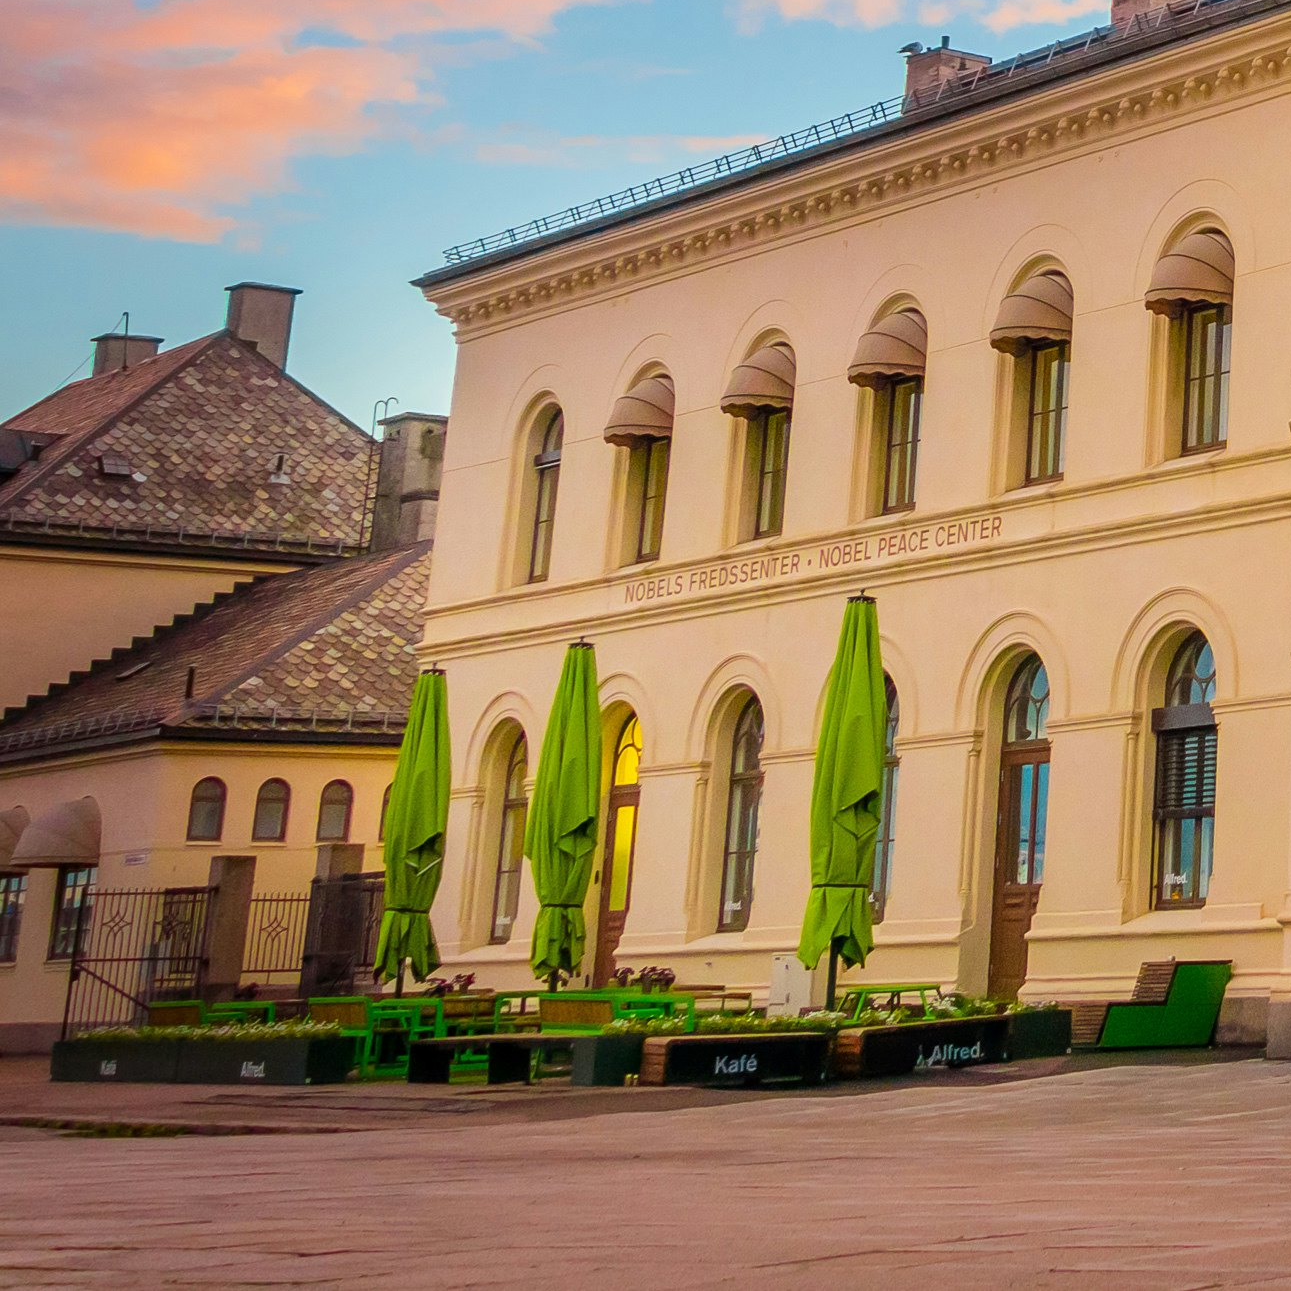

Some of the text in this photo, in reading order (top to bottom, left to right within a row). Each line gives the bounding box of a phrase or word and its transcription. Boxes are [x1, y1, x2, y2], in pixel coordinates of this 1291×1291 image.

[624, 516, 1003, 604] NOBELS FREDSSENTER NOBEL PEACE CENTER
[714, 1053, 758, 1074] Kafé
[928, 1042, 984, 1066] Alfred.
